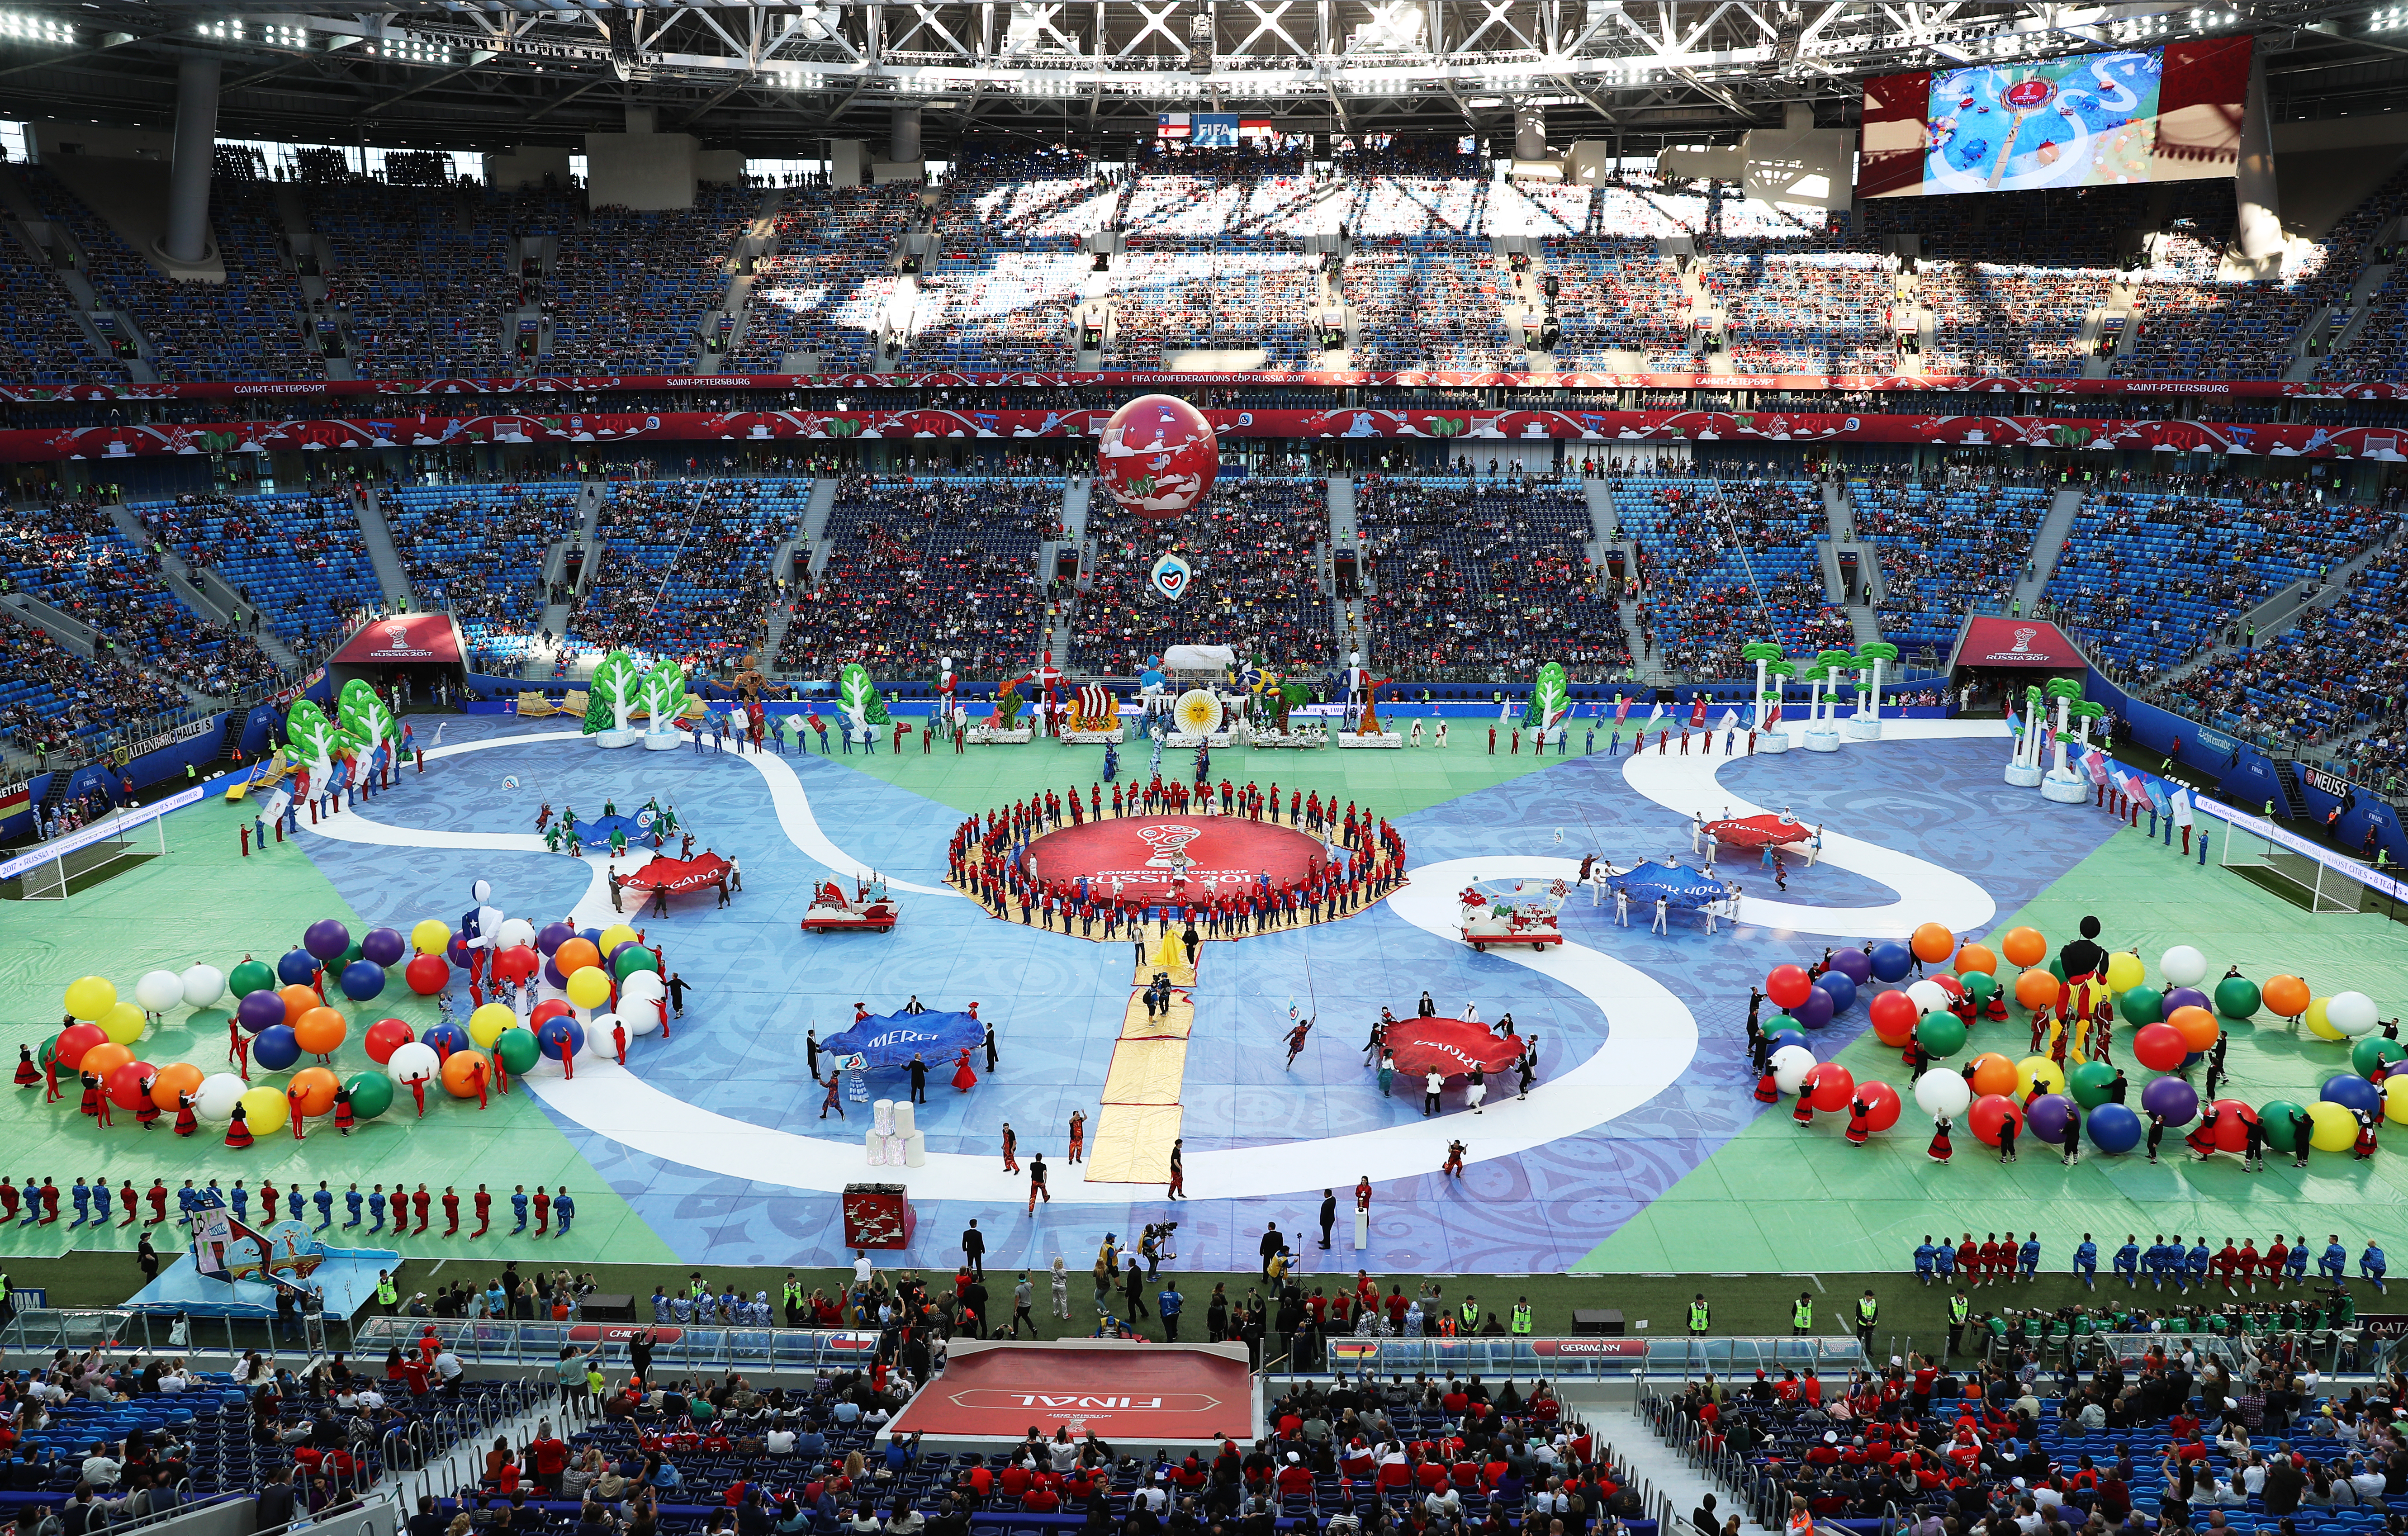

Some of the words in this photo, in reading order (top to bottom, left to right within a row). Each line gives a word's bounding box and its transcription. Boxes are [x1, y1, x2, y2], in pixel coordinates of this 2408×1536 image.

[1199, 124, 1231, 136] FIFA
[234, 384, 327, 393] САНКТ-ПЕТЕРБУРГ
[2126, 384, 2229, 392] SAINT-PETERSBURG
[176, 723, 200, 740] HALLE
[205, 720, 213, 730] S.
[2252, 766, 2263, 775] FINAL
[83, 777, 97, 787] FINAL
[2313, 772, 2348, 798] NEUSS
[2369, 812, 2383, 824] FINAL
[2, 863, 17, 875] 2017
[24, 850, 49, 866] RUSSIA
[177, 791, 198, 804] WINNER
[2201, 800, 2212, 810] FIFA
[2264, 826, 2281, 839] Rusia
[2282, 834, 2295, 844] 2017
[2299, 842, 2321, 858] RUSSIA
[2332, 858, 2348, 870] HOST
[2349, 865, 2367, 879] CITIES
[2380, 879, 2403, 895] TEAMS
[867, 1030, 939, 1048] MERCI
[1413, 1040, 1487, 1070] DANKE
[1787, 1388, 1797, 1399] 21
[1010, 1394, 1162, 1408] FINAL
